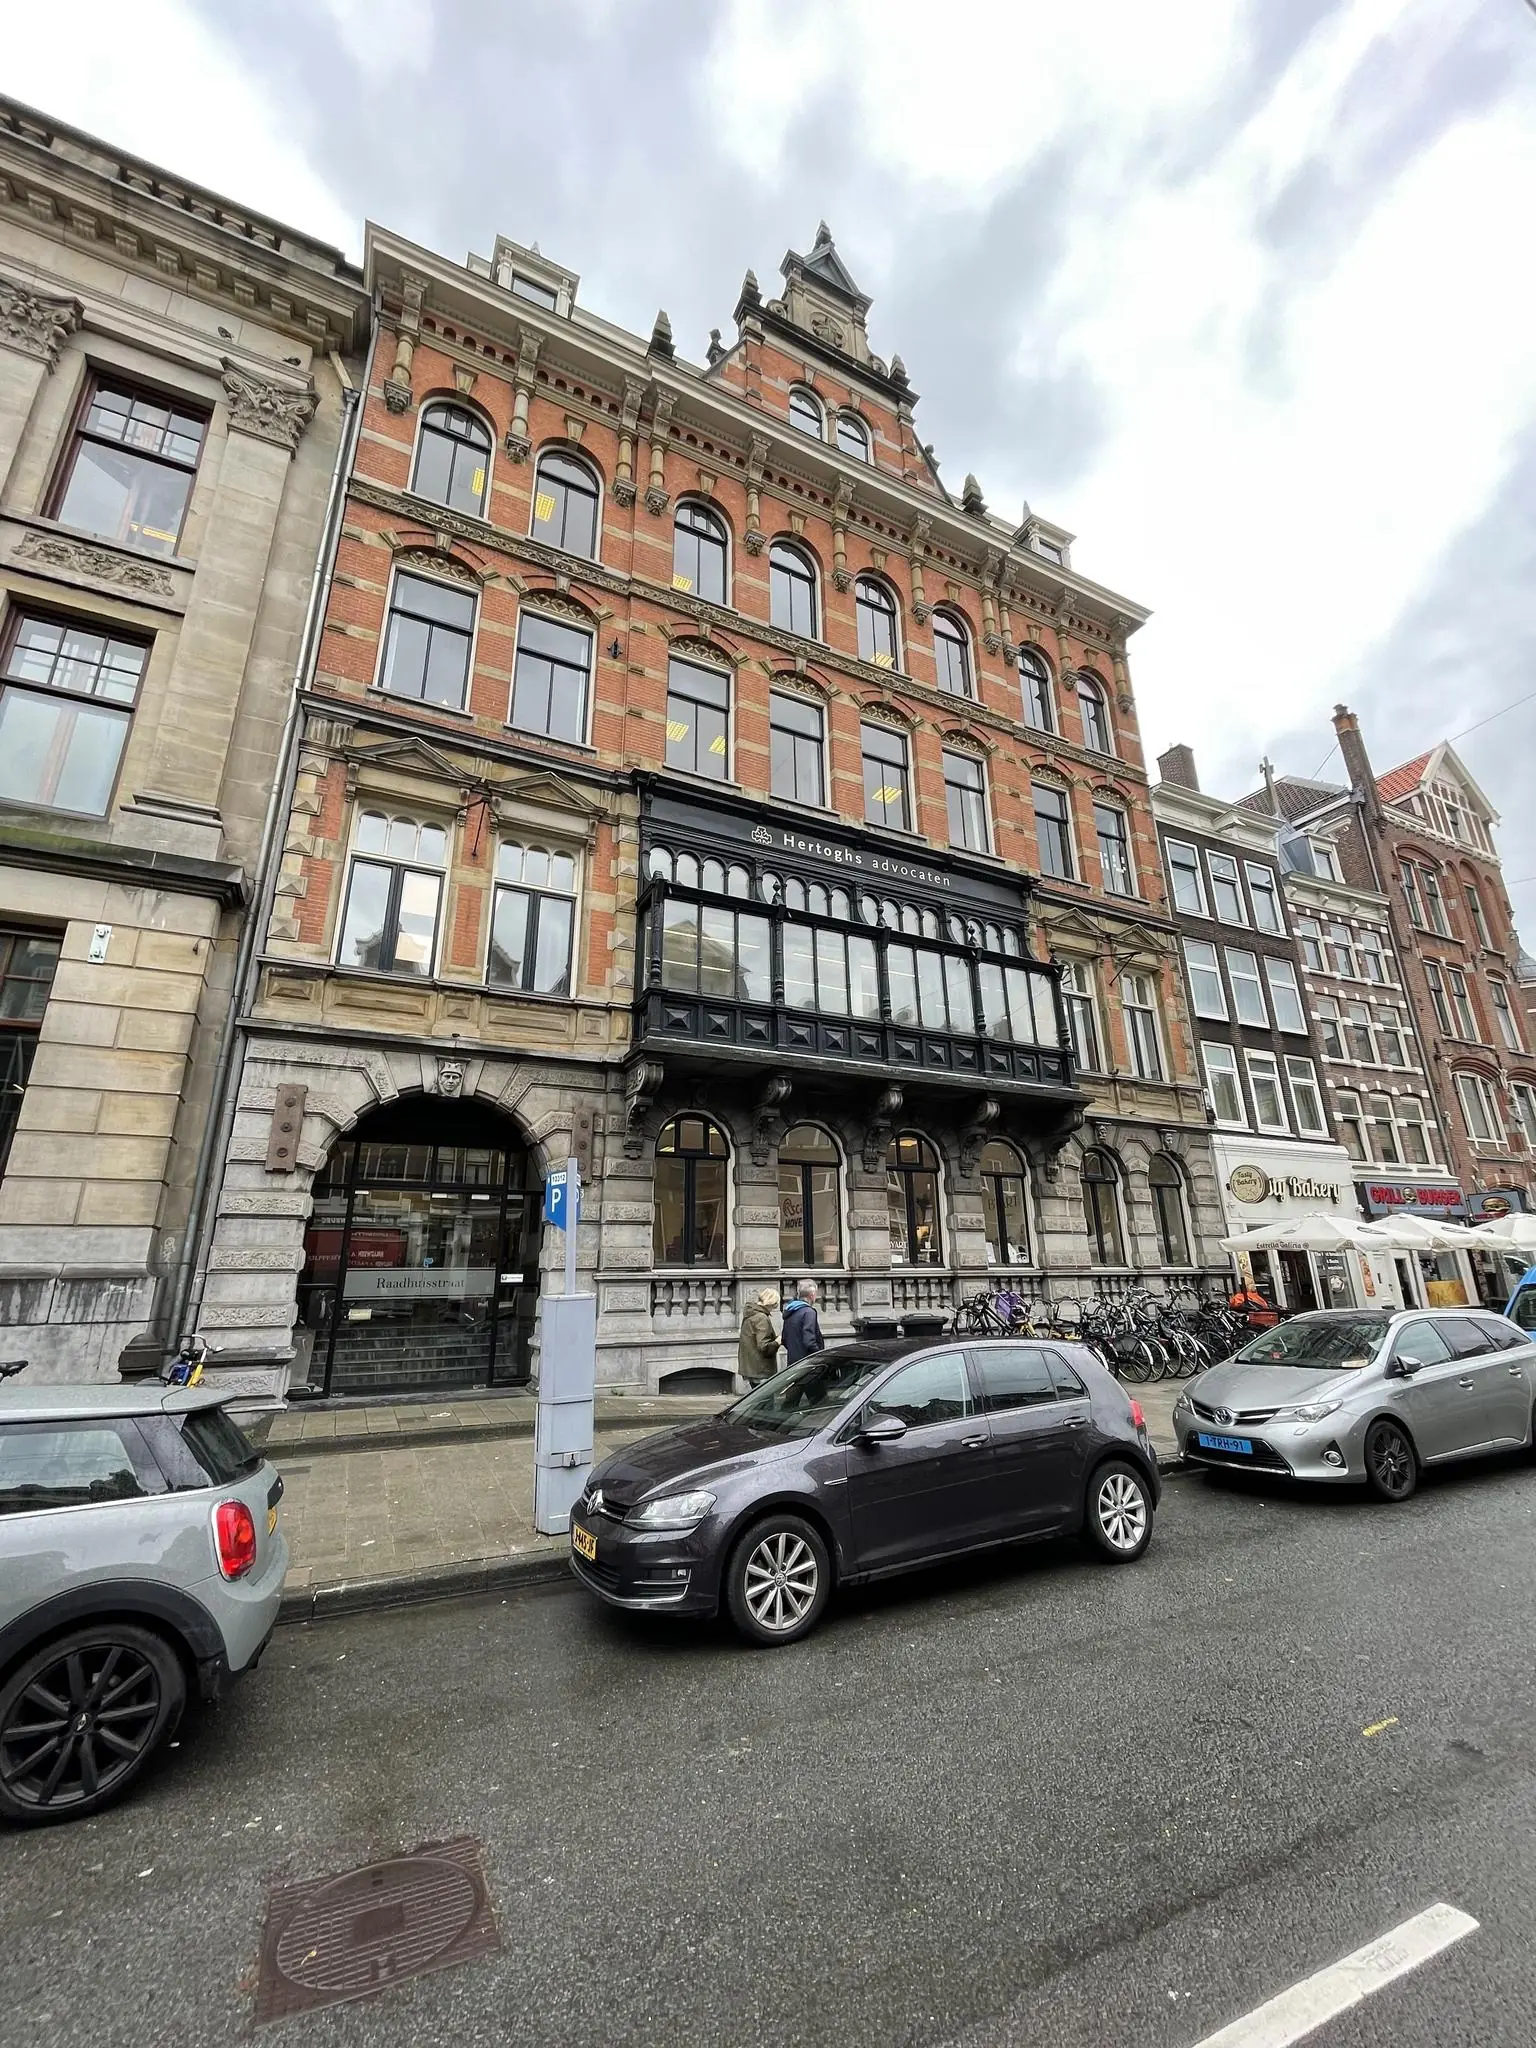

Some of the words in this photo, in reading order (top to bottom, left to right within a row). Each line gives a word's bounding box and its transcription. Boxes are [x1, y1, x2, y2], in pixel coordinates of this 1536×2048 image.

[783, 833, 862, 865] Hertoghs
[872, 857, 951, 887] advocaten
[1235, 1178, 1257, 1186] Bakery
[1267, 1177, 1287, 1202] sty
[1289, 1176, 1341, 1204] Bakery
[551, 1188, 562, 1213] P
[1370, 1186, 1405, 1205] GRILL
[1416, 1188, 1463, 1206] BURGER
[376, 1277, 465, 1290] Raadhuisstraat
